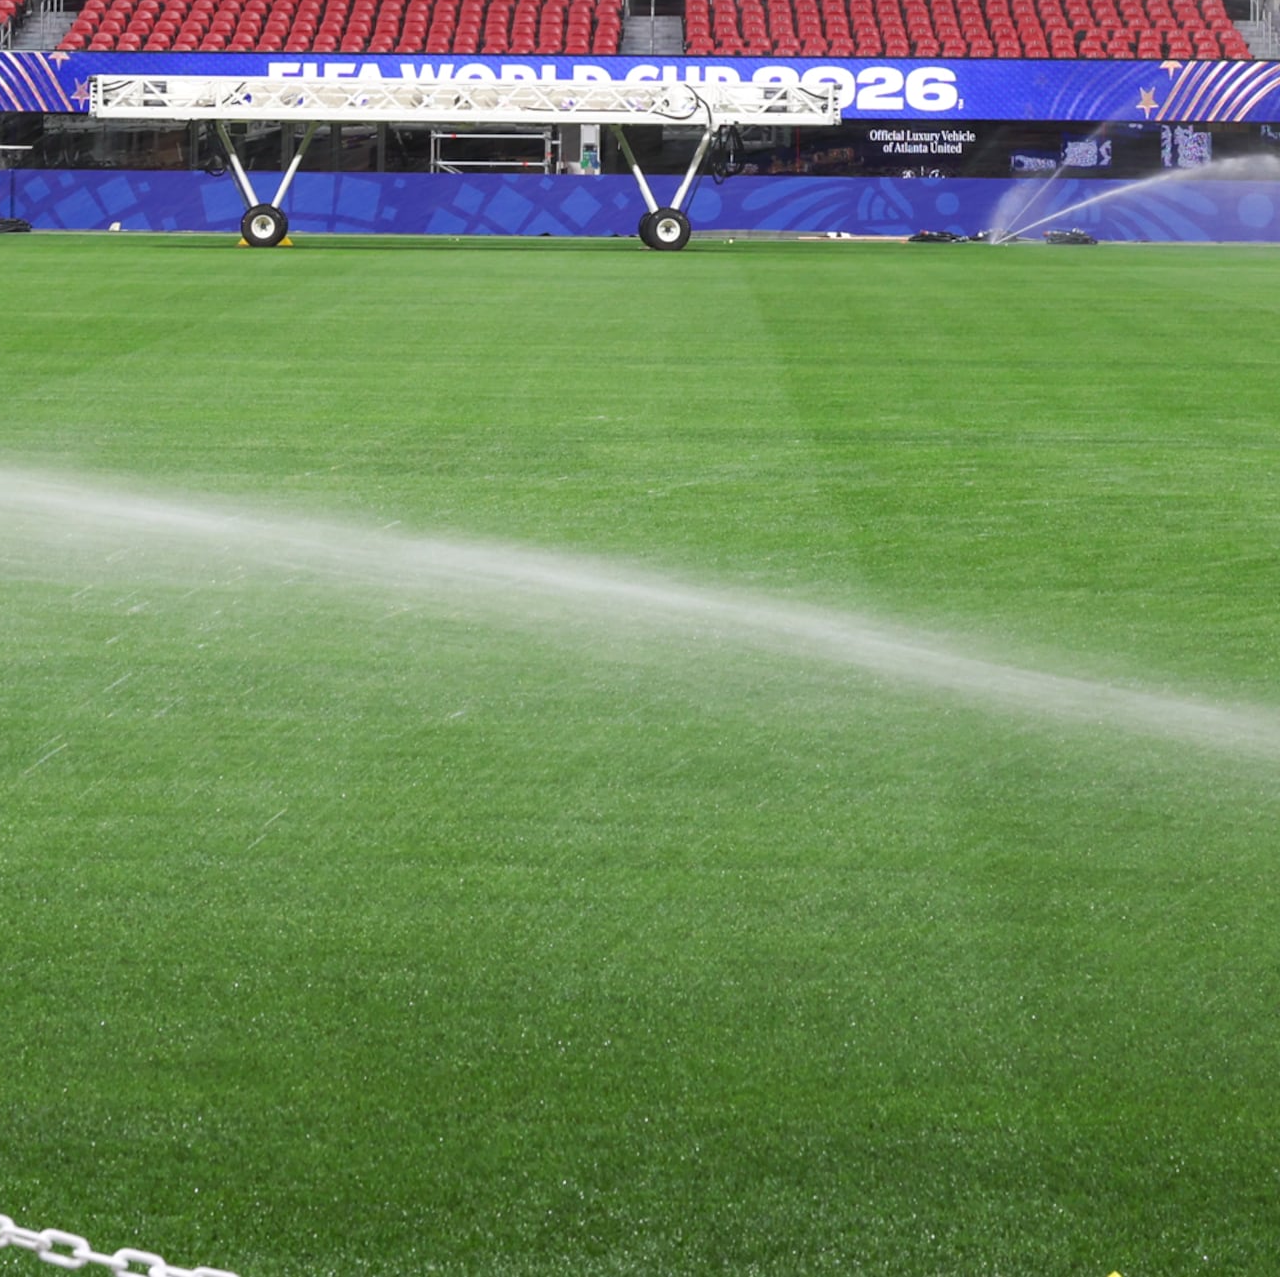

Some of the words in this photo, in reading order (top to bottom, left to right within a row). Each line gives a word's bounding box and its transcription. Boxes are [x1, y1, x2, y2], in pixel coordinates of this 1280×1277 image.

[869, 129, 904, 141] Official
[906, 130, 940, 143] Luxury
[940, 130, 976, 142] Vehicle
[882, 142, 894, 153] of
[894, 142, 928, 154] Atlanta
[929, 141, 962, 154] United
